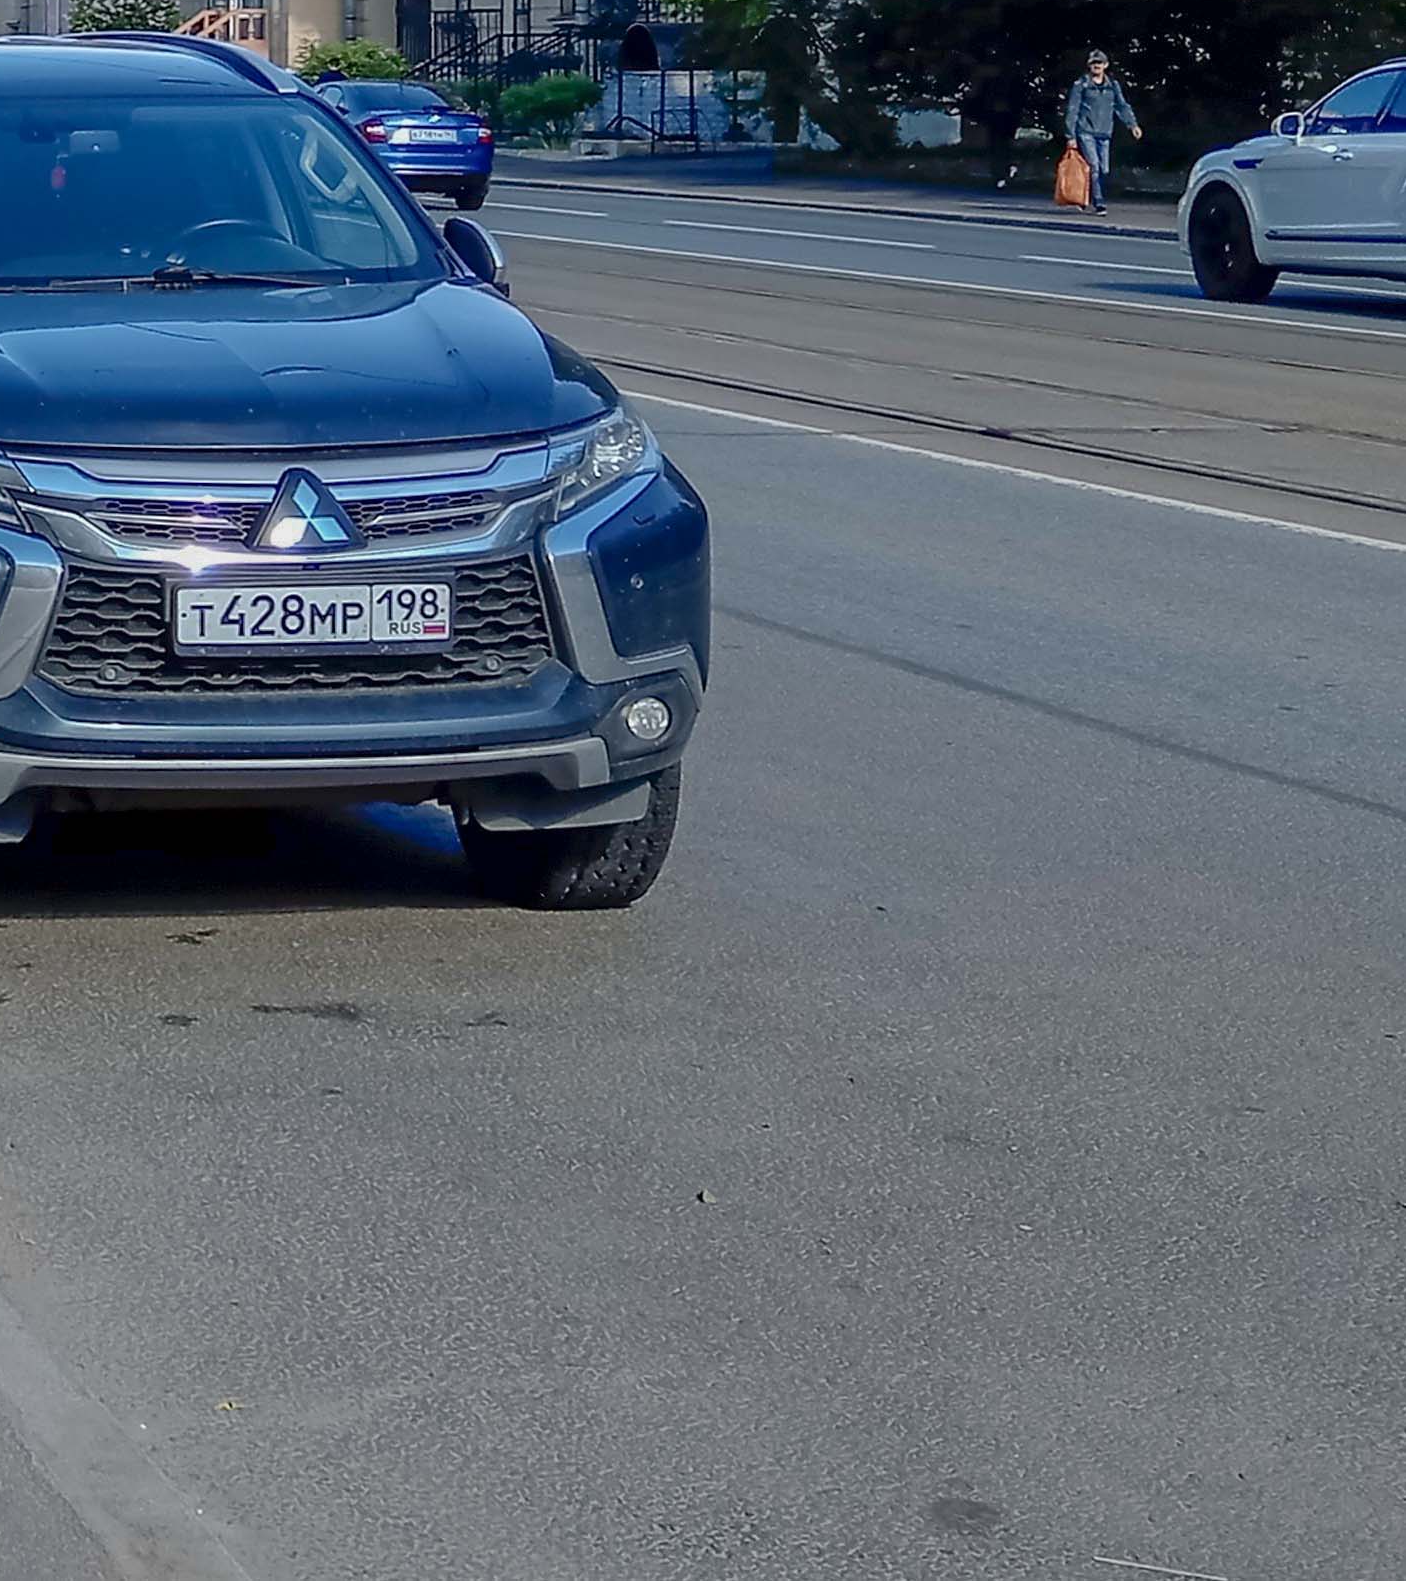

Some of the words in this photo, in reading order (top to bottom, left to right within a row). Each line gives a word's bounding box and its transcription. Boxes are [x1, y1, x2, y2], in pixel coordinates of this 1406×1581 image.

[190, 593, 364, 637] Т428МР
[376, 588, 439, 621] 198
[388, 621, 421, 635] RUS
